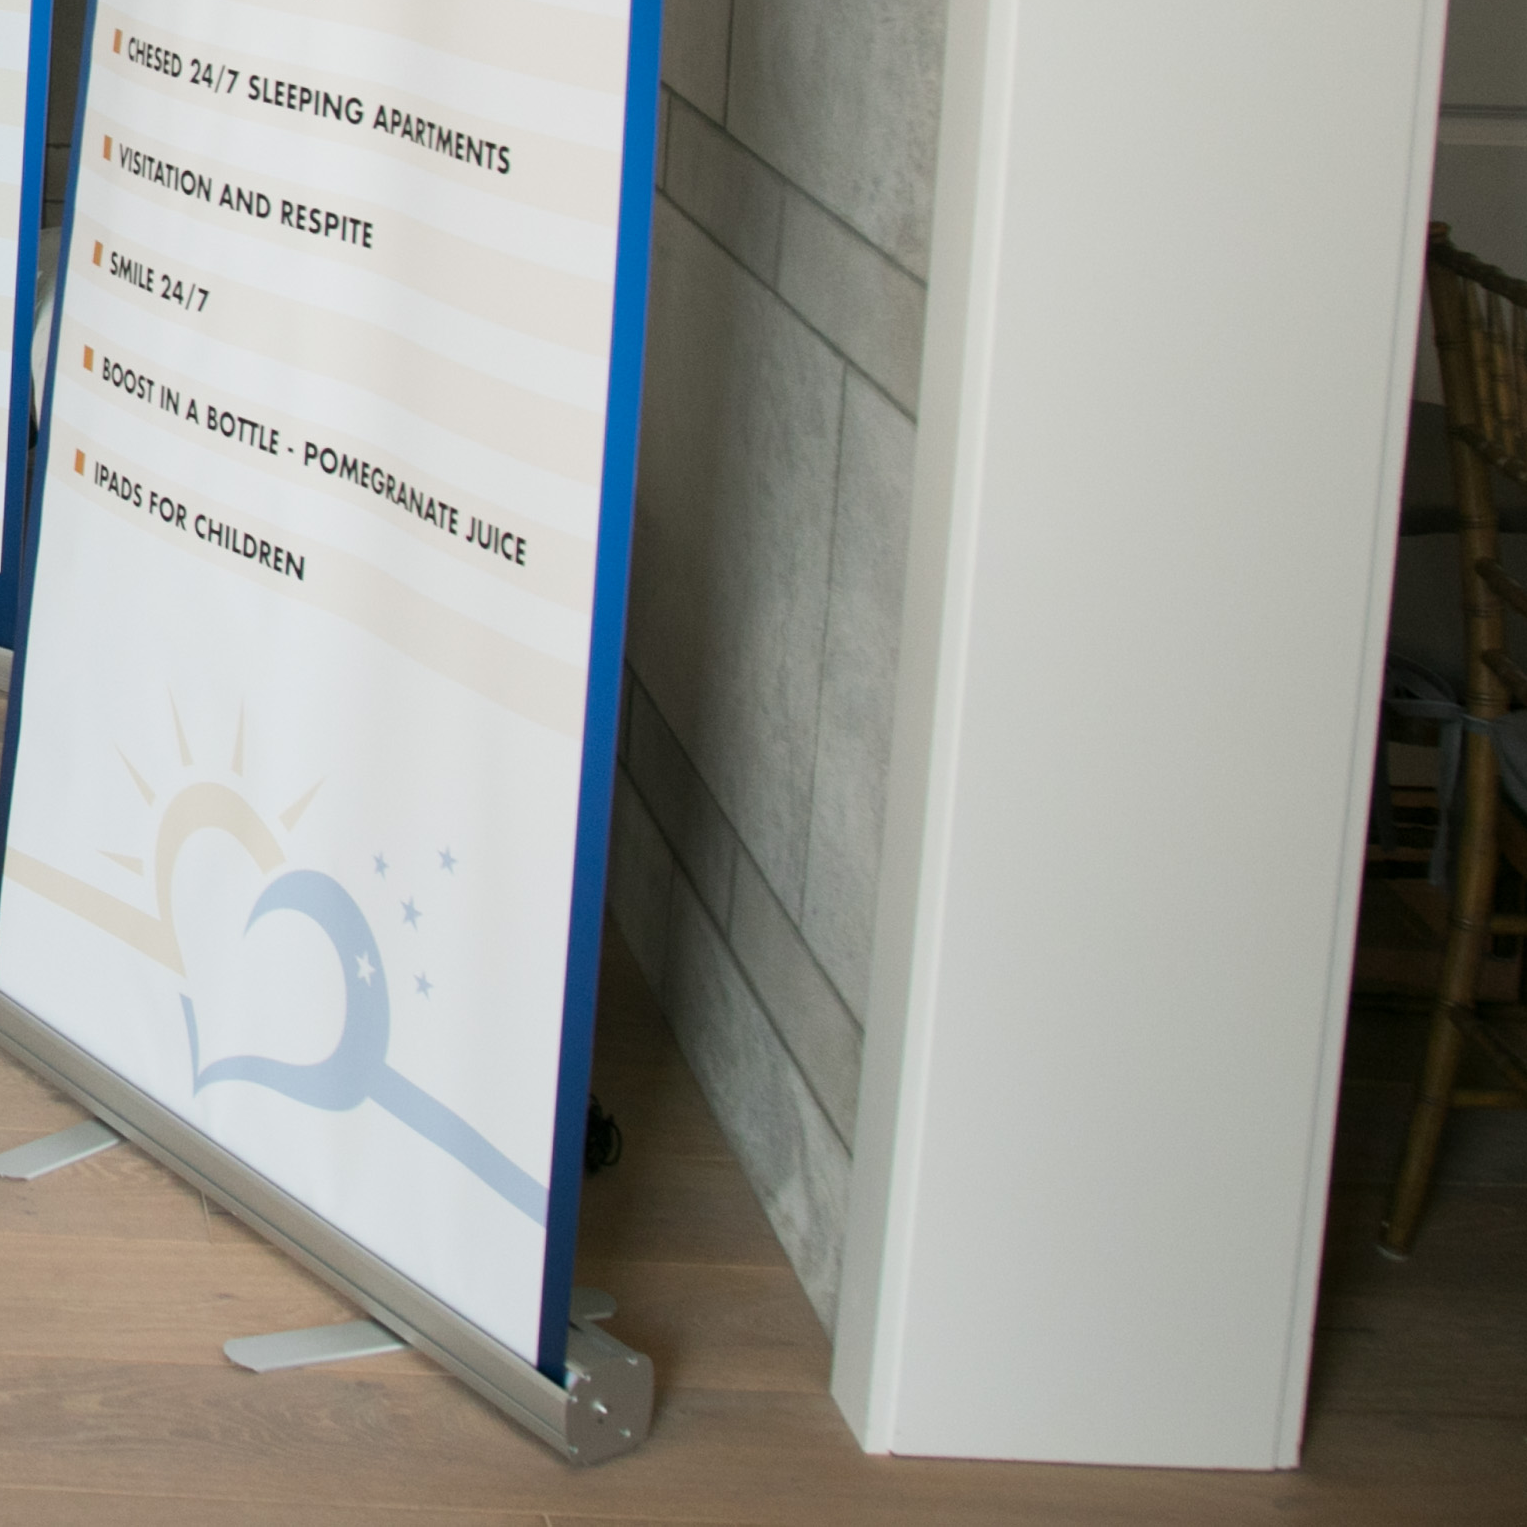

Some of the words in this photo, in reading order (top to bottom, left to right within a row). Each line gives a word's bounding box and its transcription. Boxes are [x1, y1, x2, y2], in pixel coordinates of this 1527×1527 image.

[128, 37, 182, 78] CHESED
[190, 58, 239, 93] 24/7
[248, 75, 363, 125] SLEEPING
[373, 105, 510, 174] APARTMENTS
[120, 144, 212, 202] VISITATION
[219, 184, 271, 218] AND
[281, 200, 373, 248] RESPITE
[110, 251, 154, 292] SMILE
[161, 274, 209, 312] 24/7
[102, 357, 154, 402] BOOST
[160, 386, 179, 415] IN
[186, 399, 199, 424] A
[207, 405, 279, 455] BOTTLE
[304, 441, 458, 535] POMEGRANATE
[466, 517, 526, 566] JUICE
[95, 462, 142, 507] IPADS
[149, 491, 187, 530] FOR
[194, 514, 305, 580] CHILDREN
